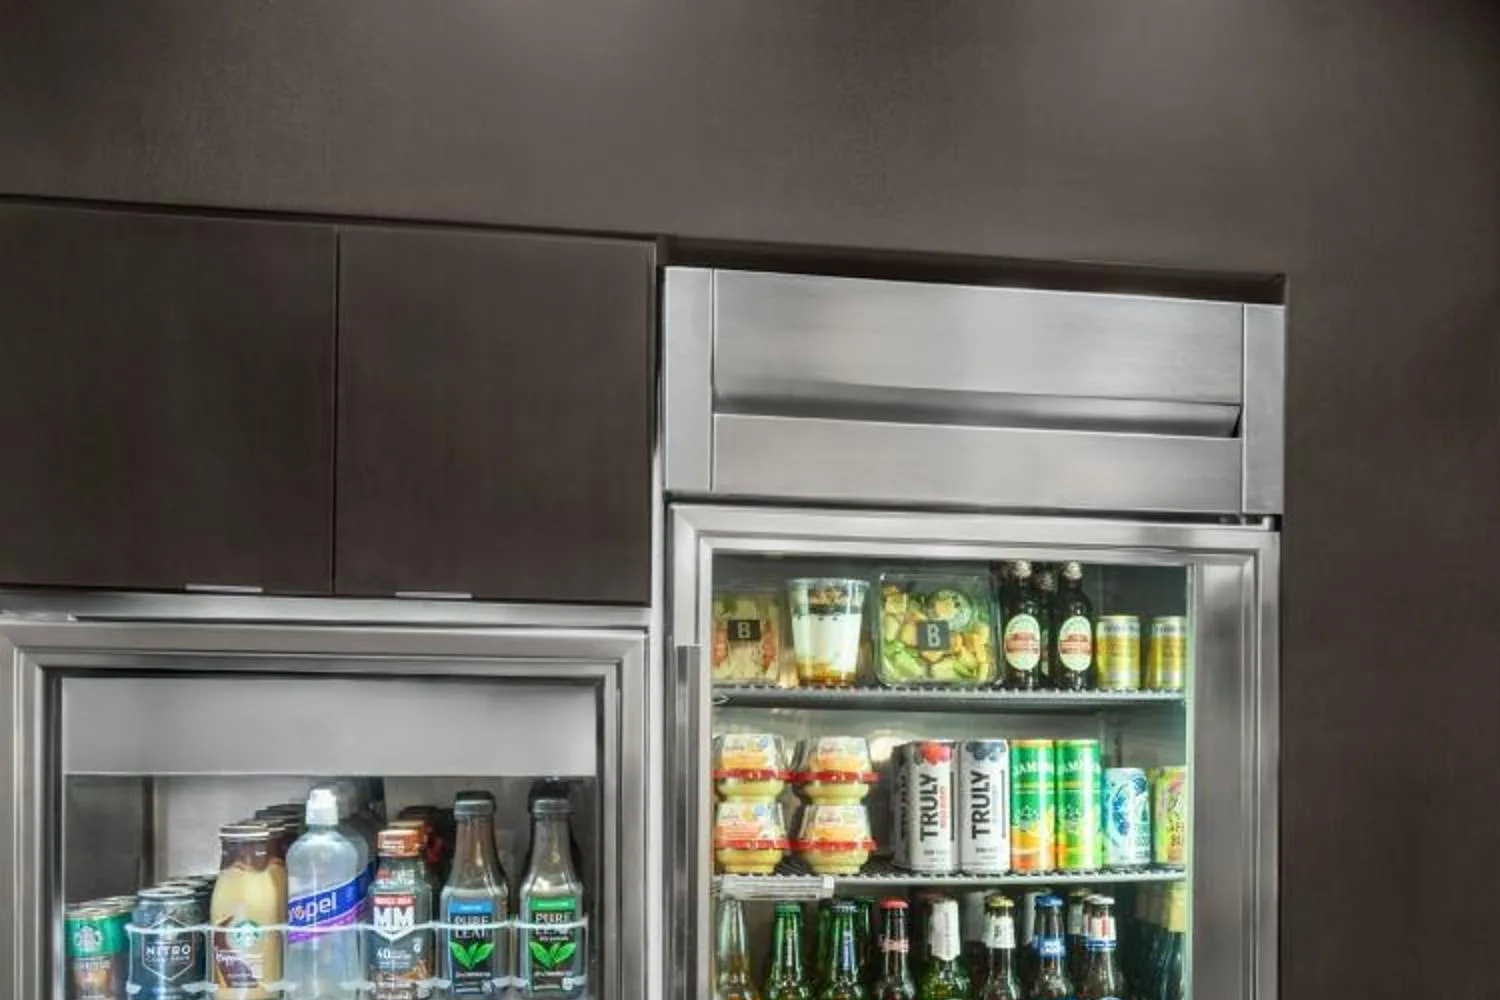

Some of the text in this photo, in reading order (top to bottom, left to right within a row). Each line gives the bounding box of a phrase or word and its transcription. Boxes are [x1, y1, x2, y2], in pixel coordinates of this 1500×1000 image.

[737, 622, 751, 638] B
[927, 623, 941, 648] B
[919, 773, 939, 842] TRULY
[971, 770, 991, 840] TRULY
[146, 944, 191, 956] NITRO
